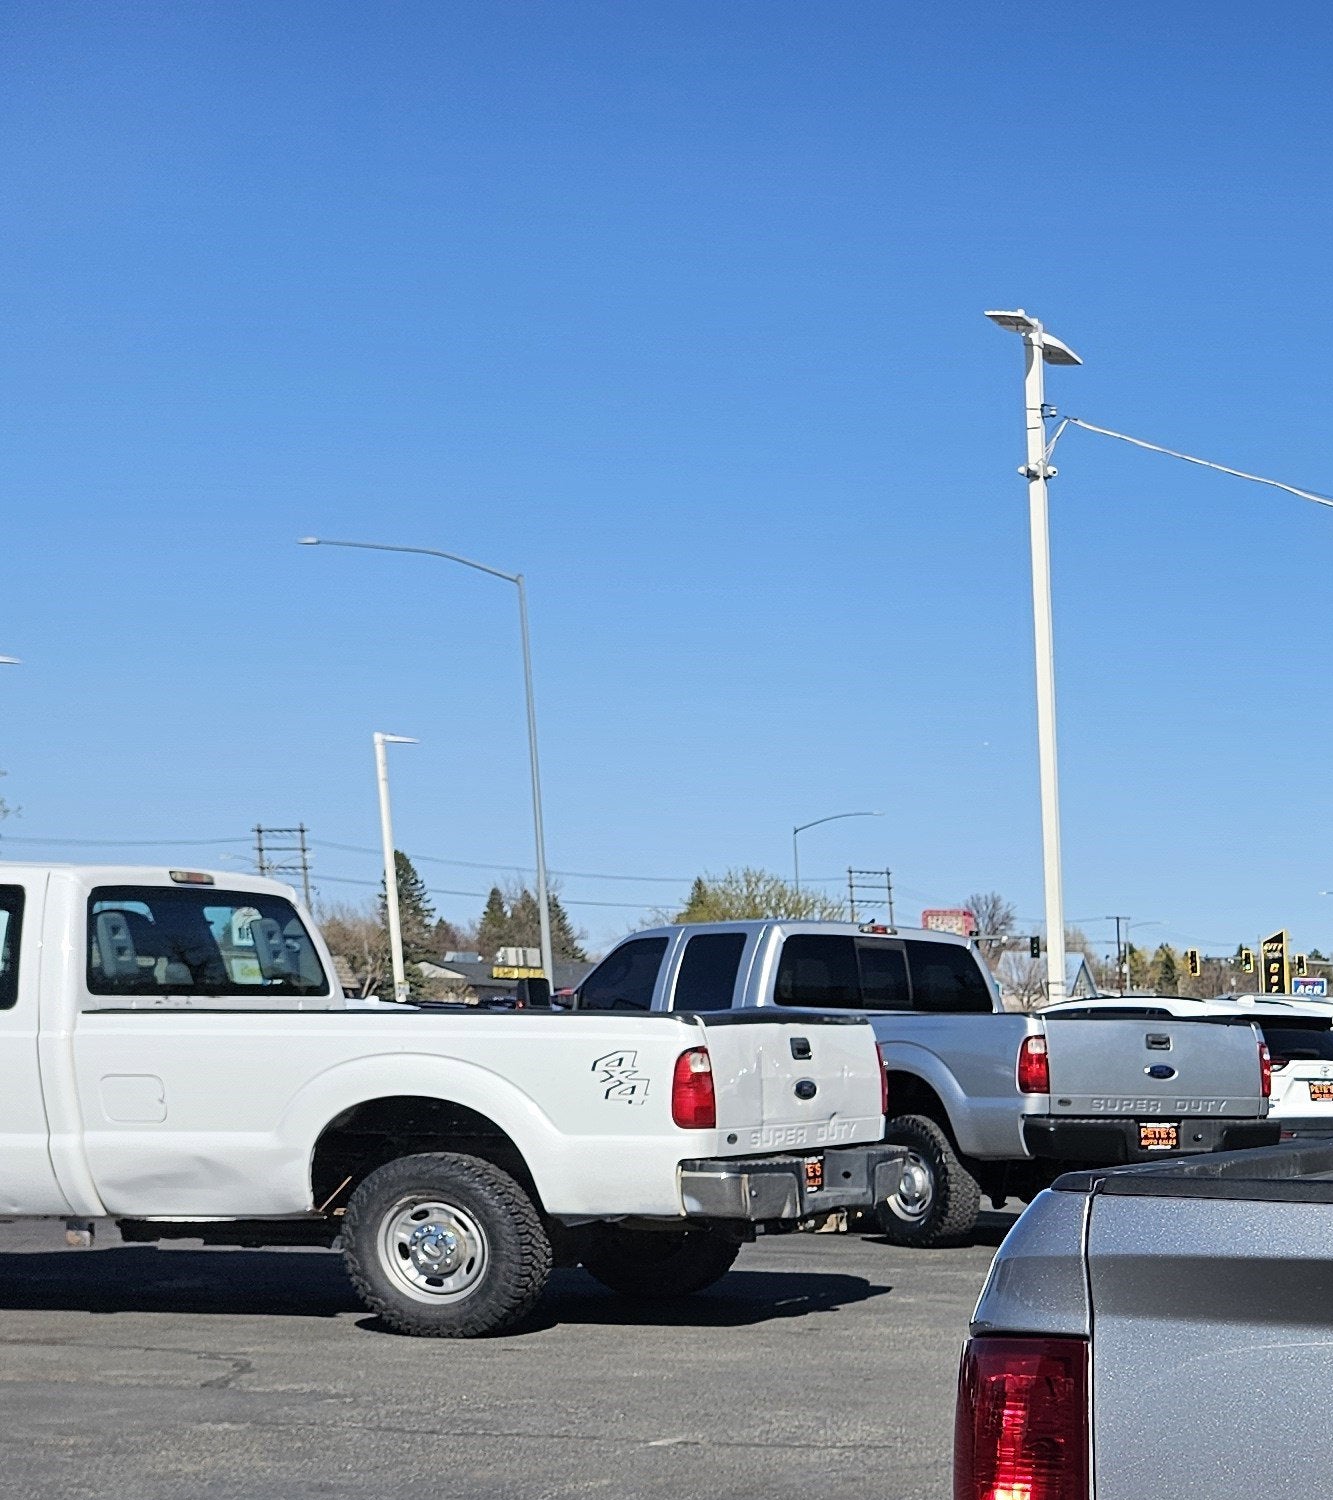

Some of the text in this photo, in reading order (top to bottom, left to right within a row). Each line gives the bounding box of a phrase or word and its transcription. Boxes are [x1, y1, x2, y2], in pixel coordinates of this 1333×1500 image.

[1090, 1098, 1228, 1113] SUPER DUTY
[749, 1121, 858, 1149] SUPER DUTY
[1140, 1127, 1177, 1139] PETE'S
